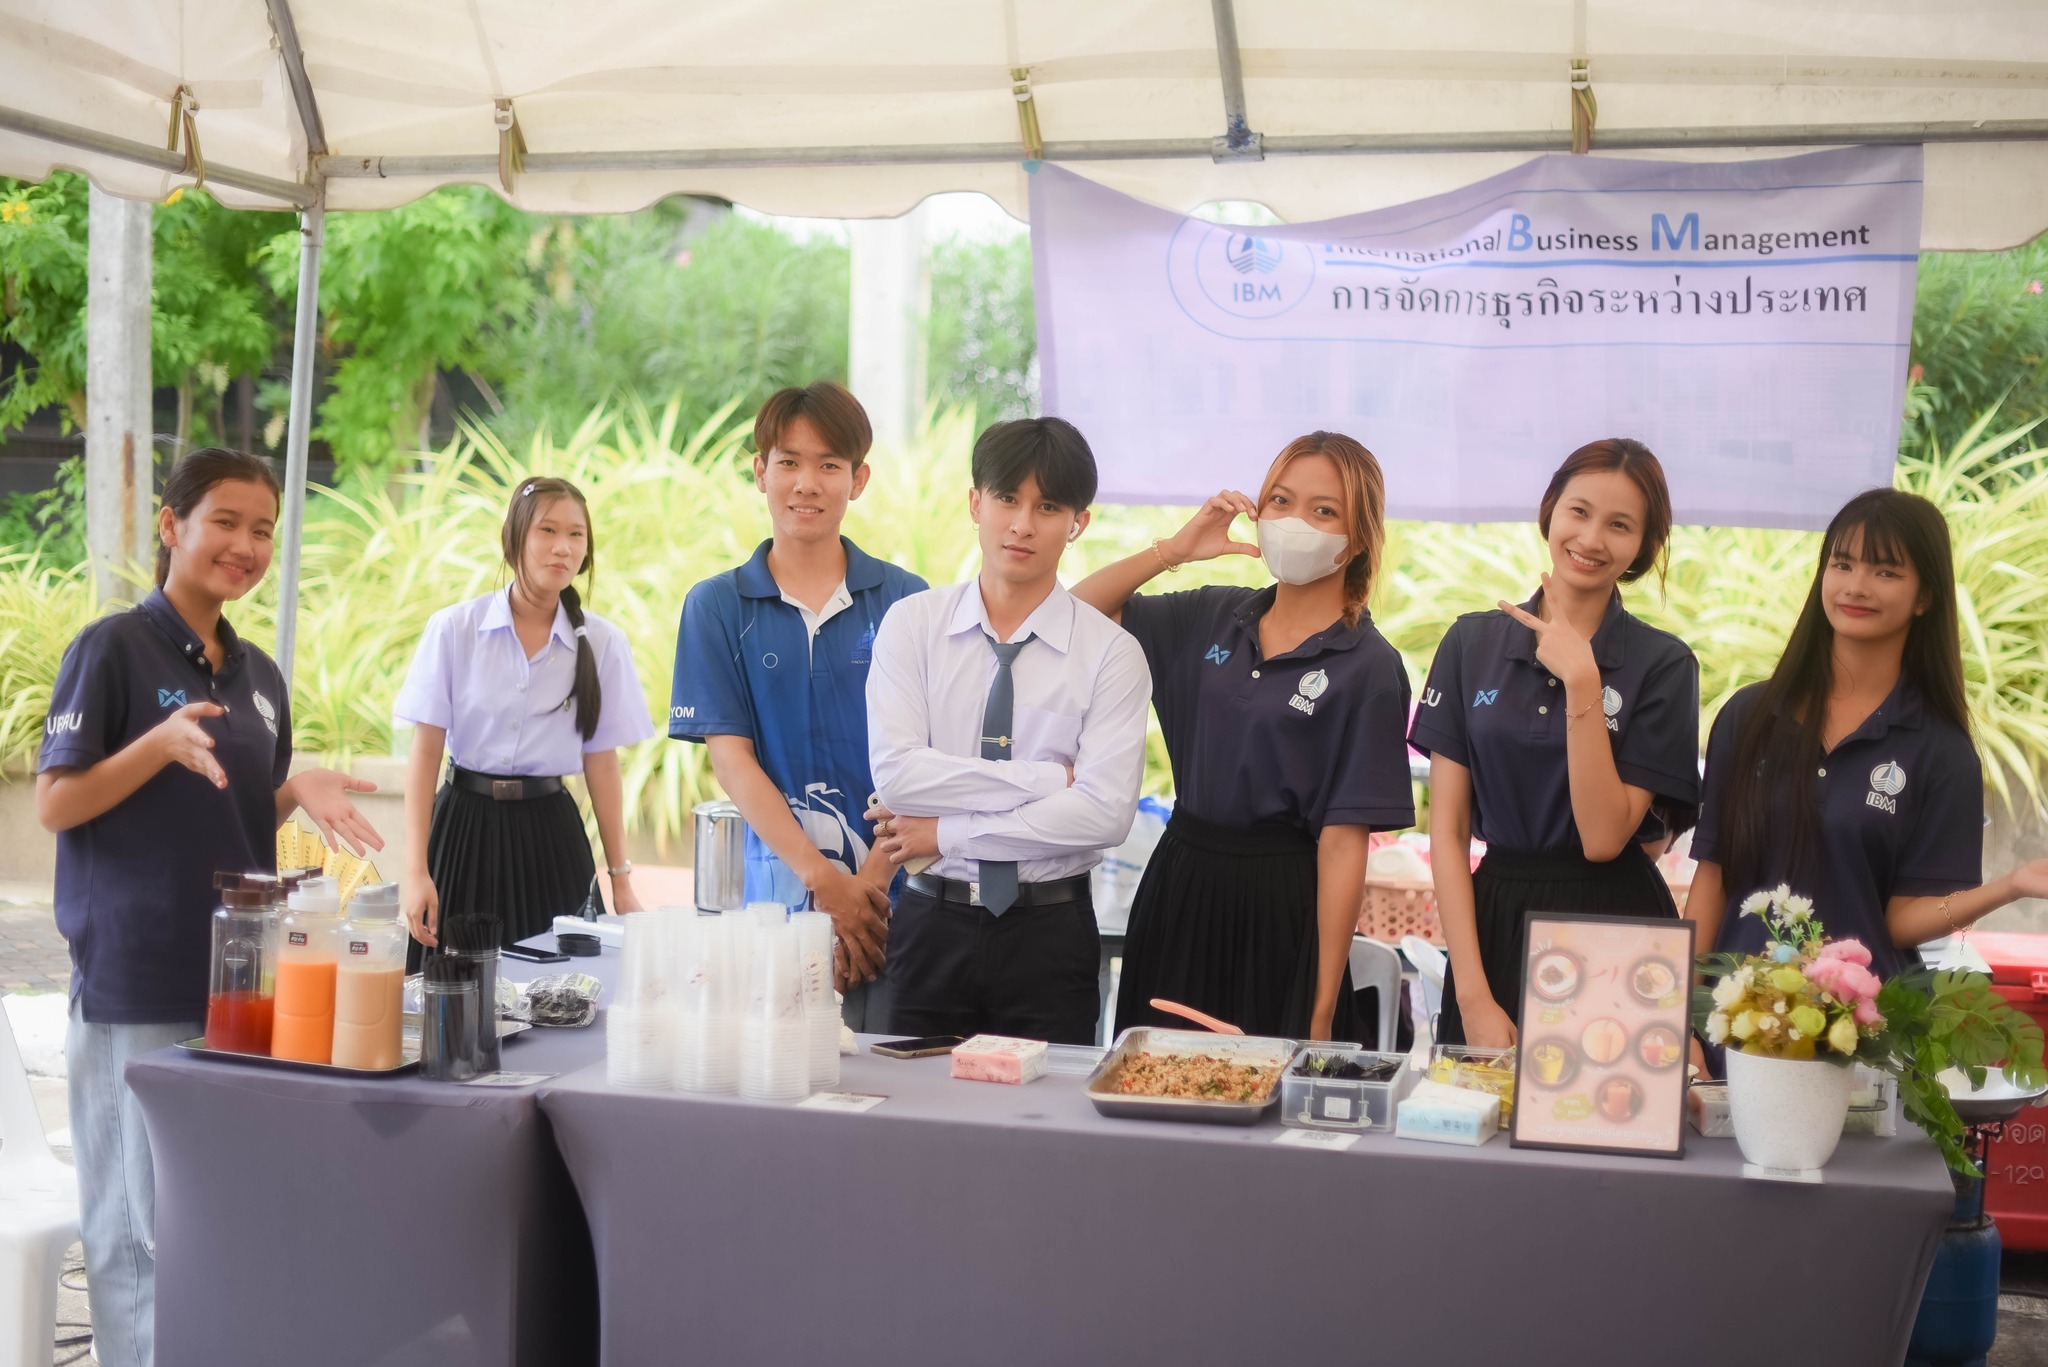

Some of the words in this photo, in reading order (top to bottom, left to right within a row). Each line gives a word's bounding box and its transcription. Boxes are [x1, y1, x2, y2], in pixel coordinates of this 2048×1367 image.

[1325, 230, 1500, 263] nternational
[1508, 214, 1638, 251] Business
[1651, 212, 1870, 254] Management
[1234, 283, 1281, 302] IBM
[1333, 275, 1867, 328] การจัดการธุรกิจระหว่างประเทศ
[1288, 694, 1314, 715] IBM
[1866, 791, 1896, 814] IBM
